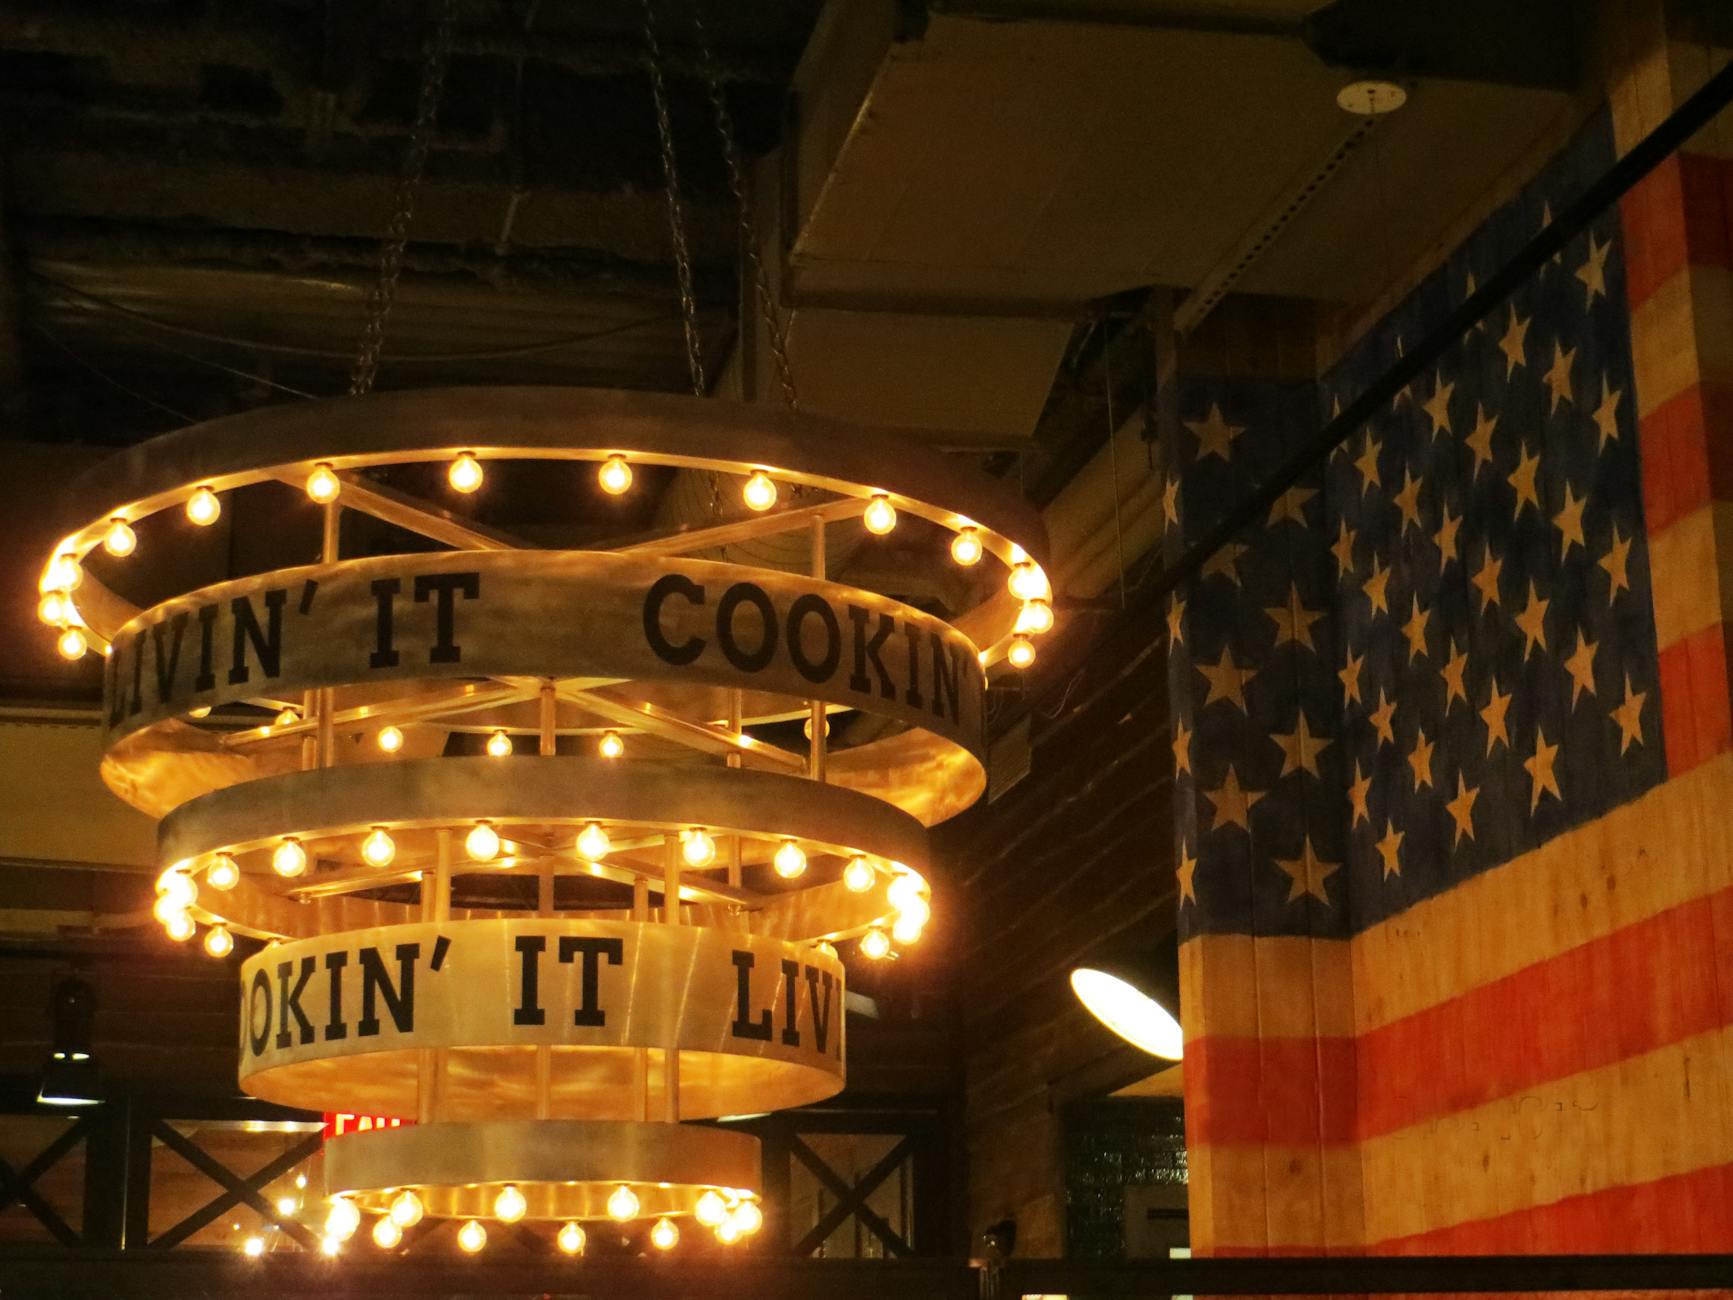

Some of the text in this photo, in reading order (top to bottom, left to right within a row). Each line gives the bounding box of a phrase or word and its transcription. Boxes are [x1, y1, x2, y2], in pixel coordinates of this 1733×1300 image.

[369, 572, 480, 668] IT
[643, 573, 968, 726] COOKIN'
[240, 935, 452, 1057] OKIN'
[513, 935, 624, 1027] IT
